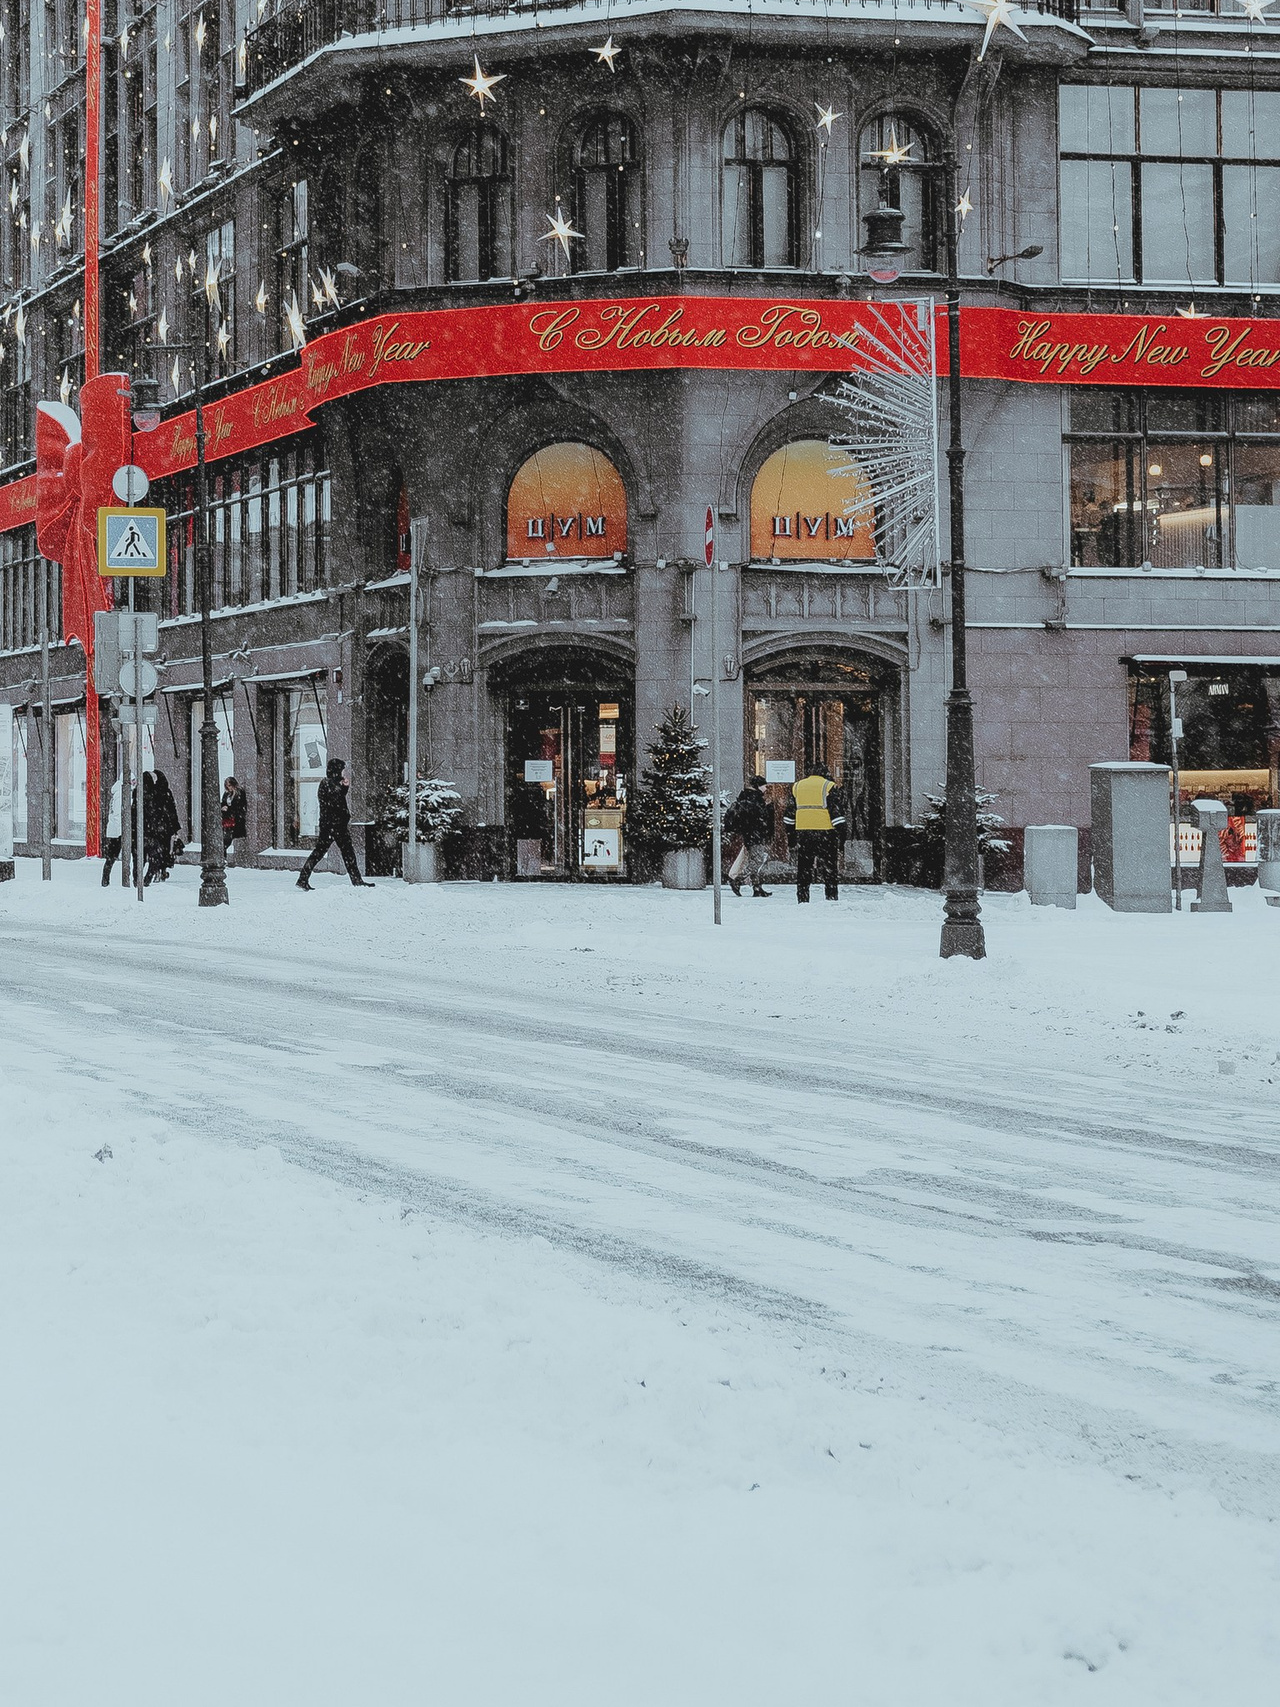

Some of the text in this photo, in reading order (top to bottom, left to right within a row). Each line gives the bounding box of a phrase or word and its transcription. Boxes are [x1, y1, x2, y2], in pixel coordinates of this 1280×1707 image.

[334, 332, 366, 379] New
[369, 322, 432, 378] Year
[529, 303, 860, 352] С Новым Годом
[1009, 320, 1109, 375] Happy
[1110, 323, 1190, 366] New
